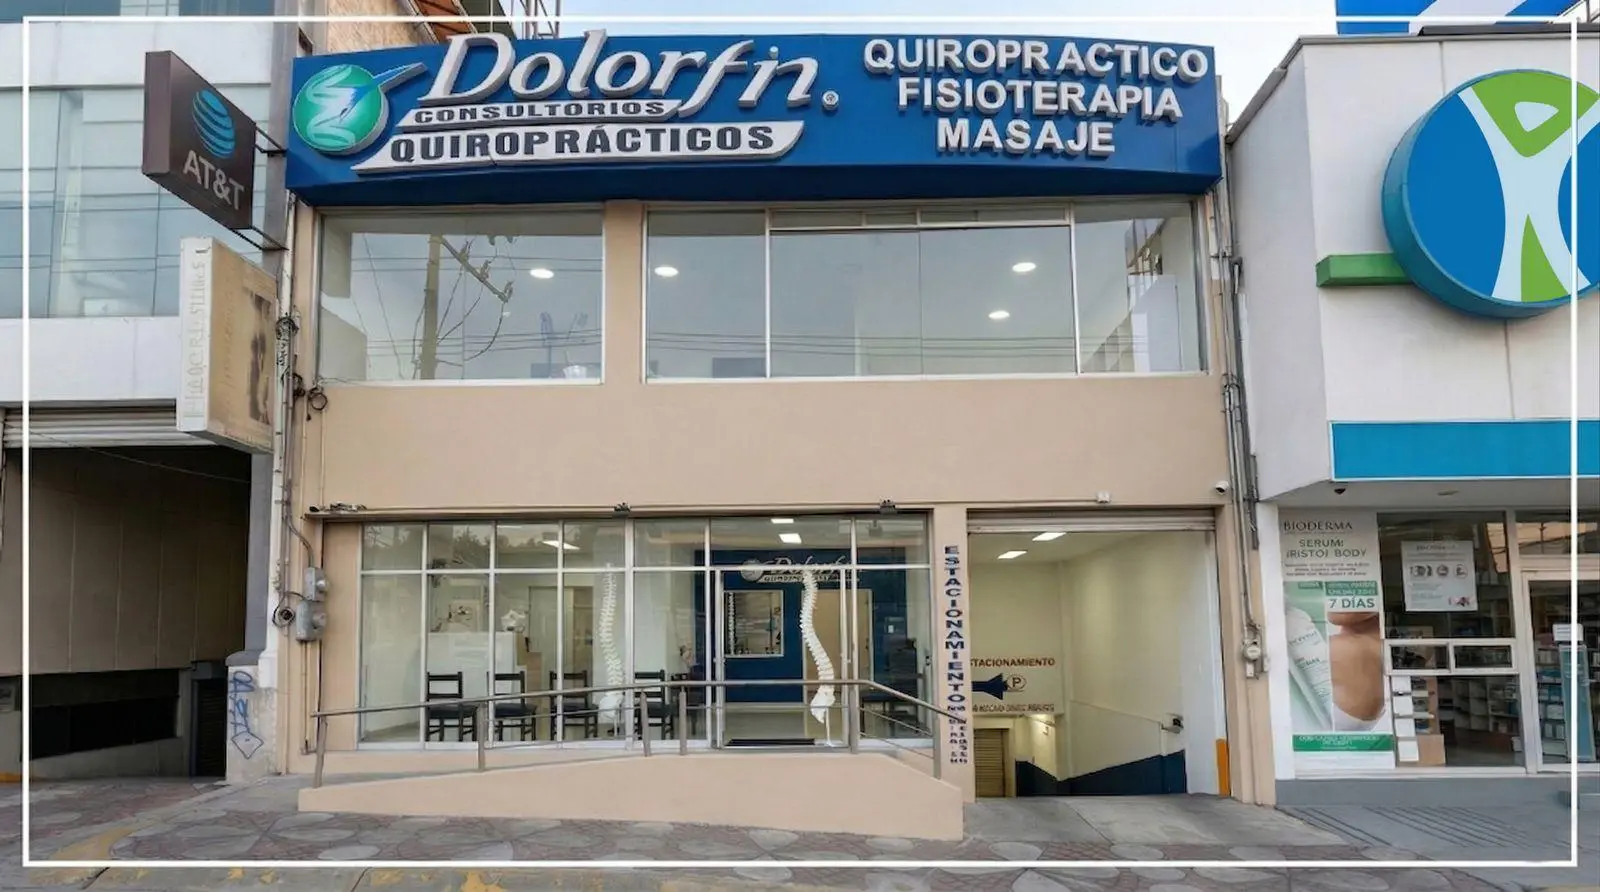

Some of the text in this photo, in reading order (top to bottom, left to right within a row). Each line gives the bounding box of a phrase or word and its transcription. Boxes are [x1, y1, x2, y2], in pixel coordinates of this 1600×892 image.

[417, 29, 819, 118] Dolorfin
[864, 38, 1208, 82] QUIROPRACTICO
[414, 100, 666, 124] CONSULTORIOS
[898, 77, 1183, 122] FISIOTERAPIA
[390, 122, 774, 163] QUIROPRÁCTICOS
[936, 118, 1115, 156] MASAJE
[183, 150, 244, 210] AT&T
[1283, 520, 1353, 531] BIODERMA
[1334, 549, 1367, 558] BODY
[1329, 595, 1375, 609] 7 DÍAS
[944, 545, 966, 703] ESTACIONAMIENTO
[1012, 677, 1022, 688] P
